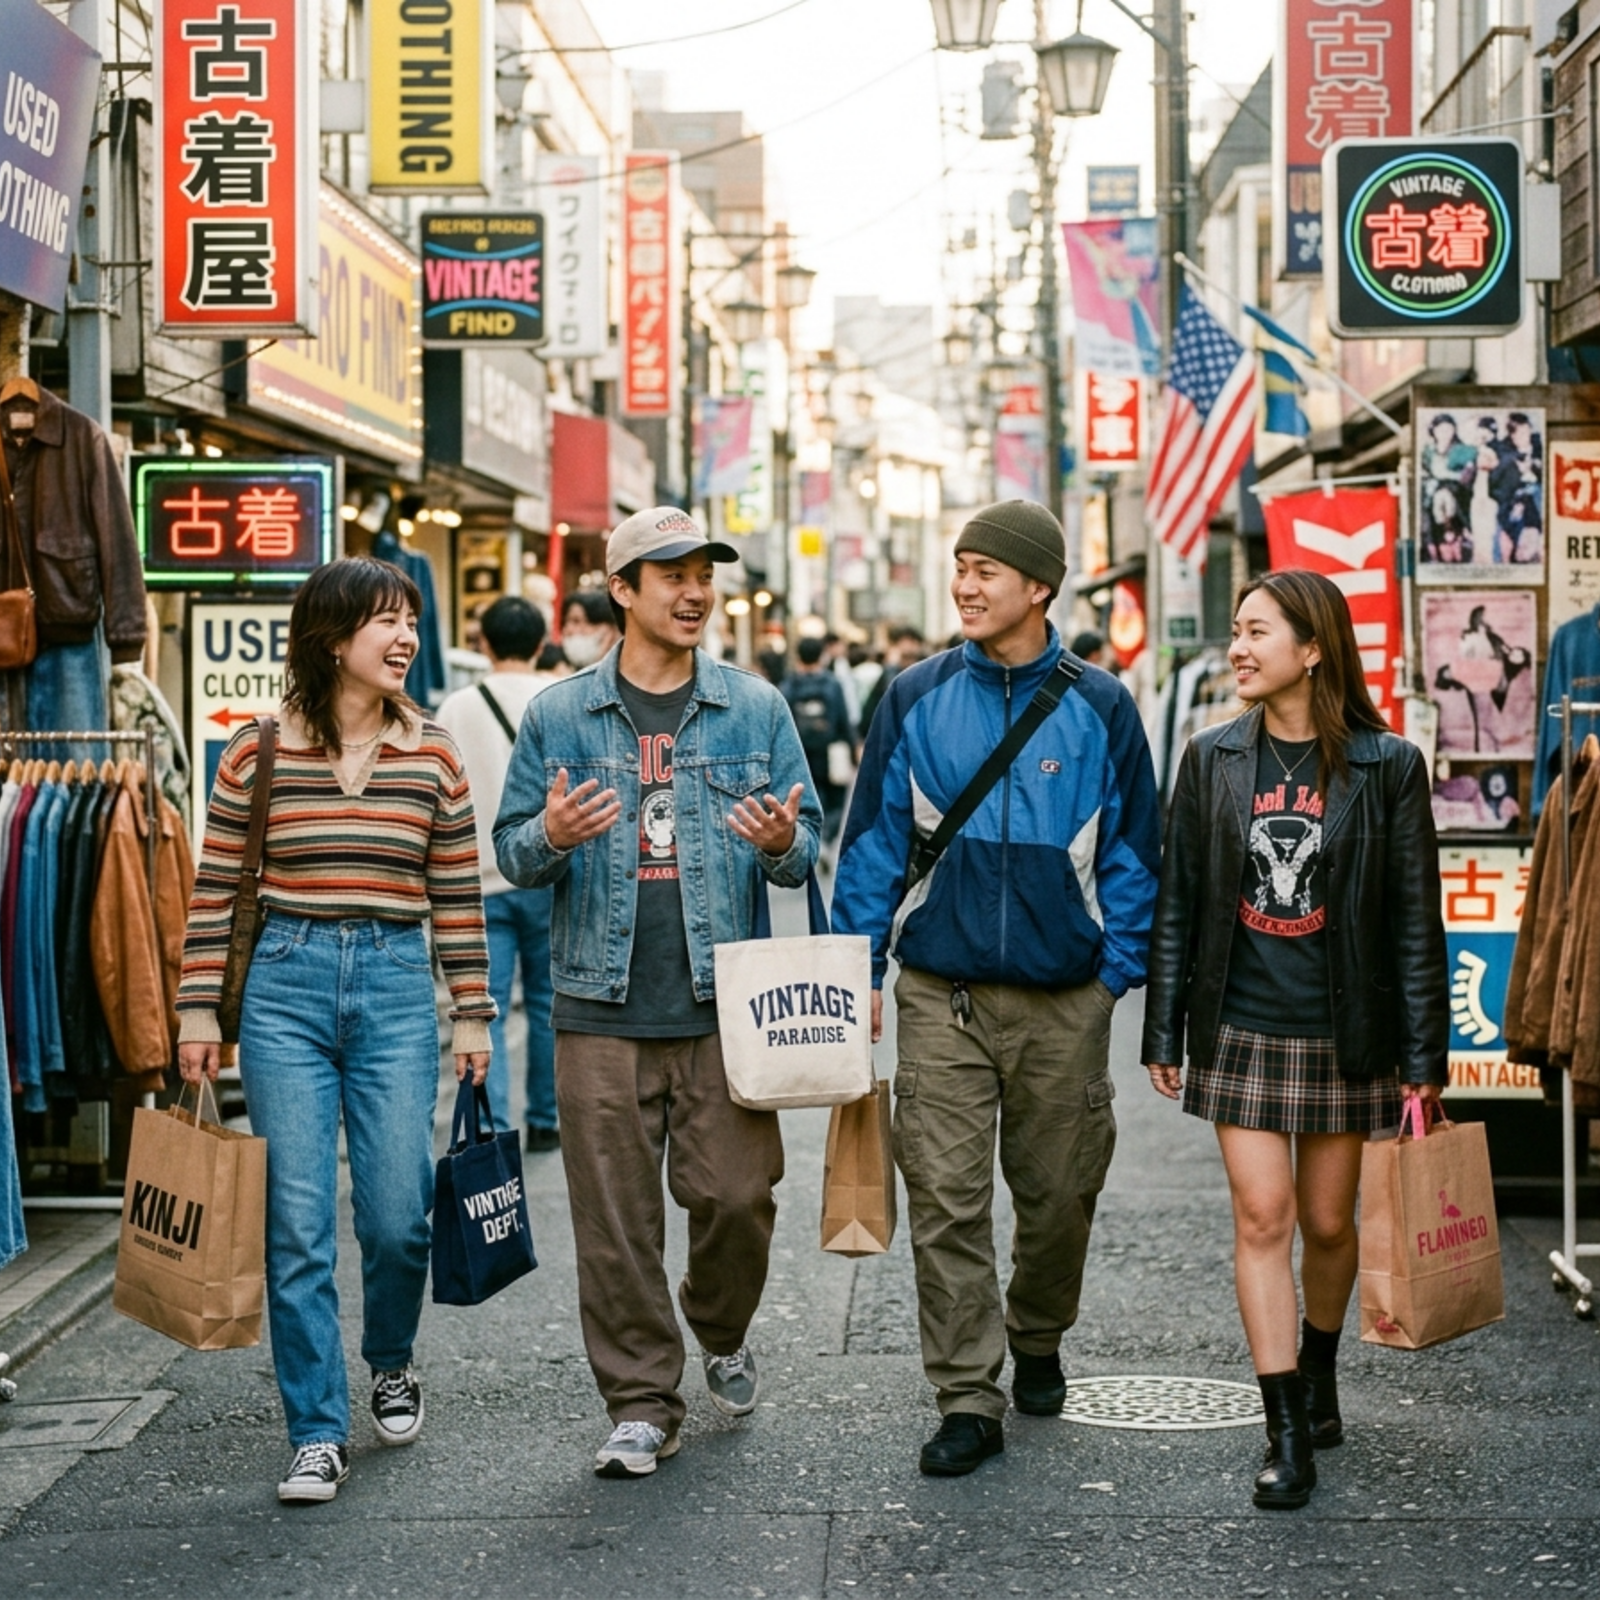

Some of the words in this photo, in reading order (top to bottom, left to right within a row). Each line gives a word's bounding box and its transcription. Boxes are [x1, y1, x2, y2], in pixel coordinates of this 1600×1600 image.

[400, 0, 453, 173] OTHING
[1305, 0, 1392, 149] 古着
[3, 71, 59, 158] USED
[179, 4, 277, 311] 古着屋
[1389, 174, 1466, 198] VINTAGE
[1365, 203, 1490, 268] 古着
[425, 257, 541, 302] VINTAGE
[449, 311, 516, 335] FIND
[163, 487, 301, 556] 古着
[1440, 859, 1531, 921] 古
[748, 982, 858, 1030] VINTAGE
[767, 1026, 846, 1047] PARADISE
[129, 1180, 204, 1250] KINJI
